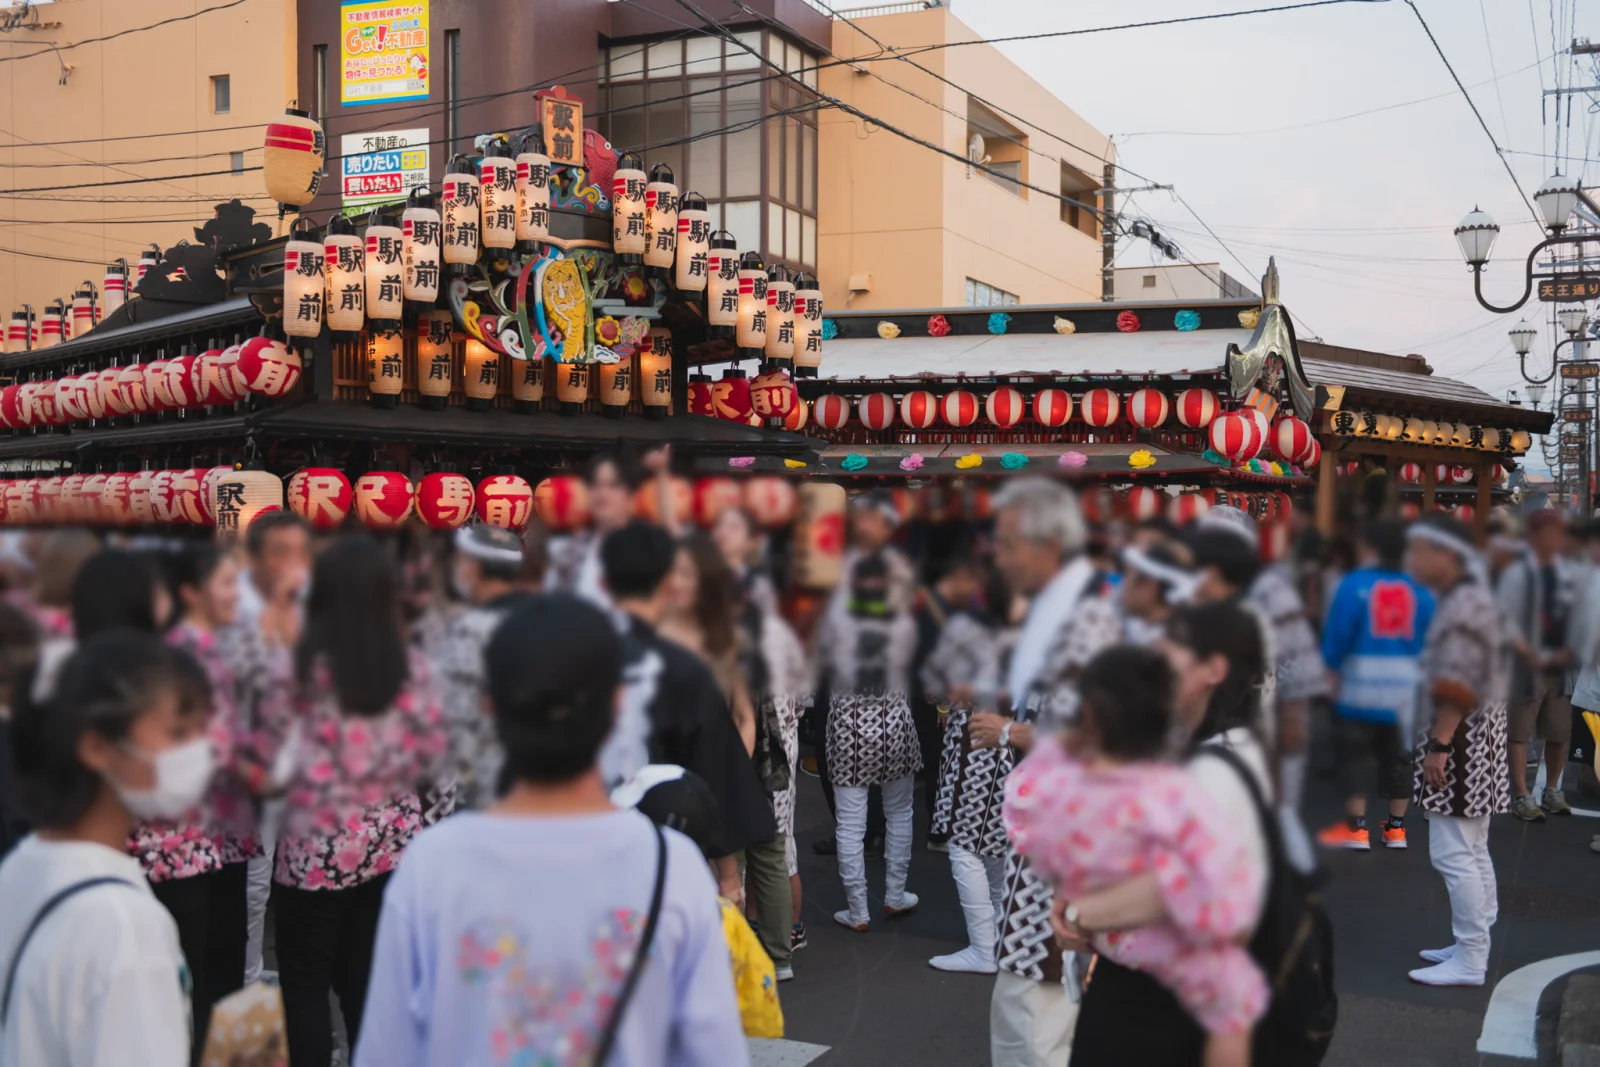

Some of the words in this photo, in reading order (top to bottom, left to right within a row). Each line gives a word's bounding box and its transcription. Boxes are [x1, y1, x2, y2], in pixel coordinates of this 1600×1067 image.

[347, 6, 424, 21] 不動産情報検索サイト
[392, 19, 419, 29] ふくしま
[363, 136, 408, 152] 不動産の
[552, 104, 574, 160] 駅前
[347, 154, 399, 173] 売りたい
[347, 176, 401, 195] 買いたい
[455, 182, 479, 250] 駅前
[493, 166, 517, 231] 駅前
[528, 164, 551, 230] 駅前
[625, 179, 646, 238] 駅前
[655, 190, 678, 253] 駅前
[376, 237, 403, 304] 駅前
[412, 220, 439, 290] 駅前
[688, 219, 710, 278] 駅前
[296, 251, 324, 324] 駅前
[337, 246, 362, 312] 駅前
[718, 257, 740, 313] 駅前
[1541, 284, 1599, 297] 天王通り
[775, 290, 796, 344] 駅前
[804, 298, 822, 352] 駅前
[427, 320, 451, 380] 駅前
[650, 335, 672, 393] 駅前
[750, 373, 794, 415] 前
[1335, 412, 1355, 435] 東
[1360, 412, 1379, 436] 東
[484, 475, 533, 529] 前
